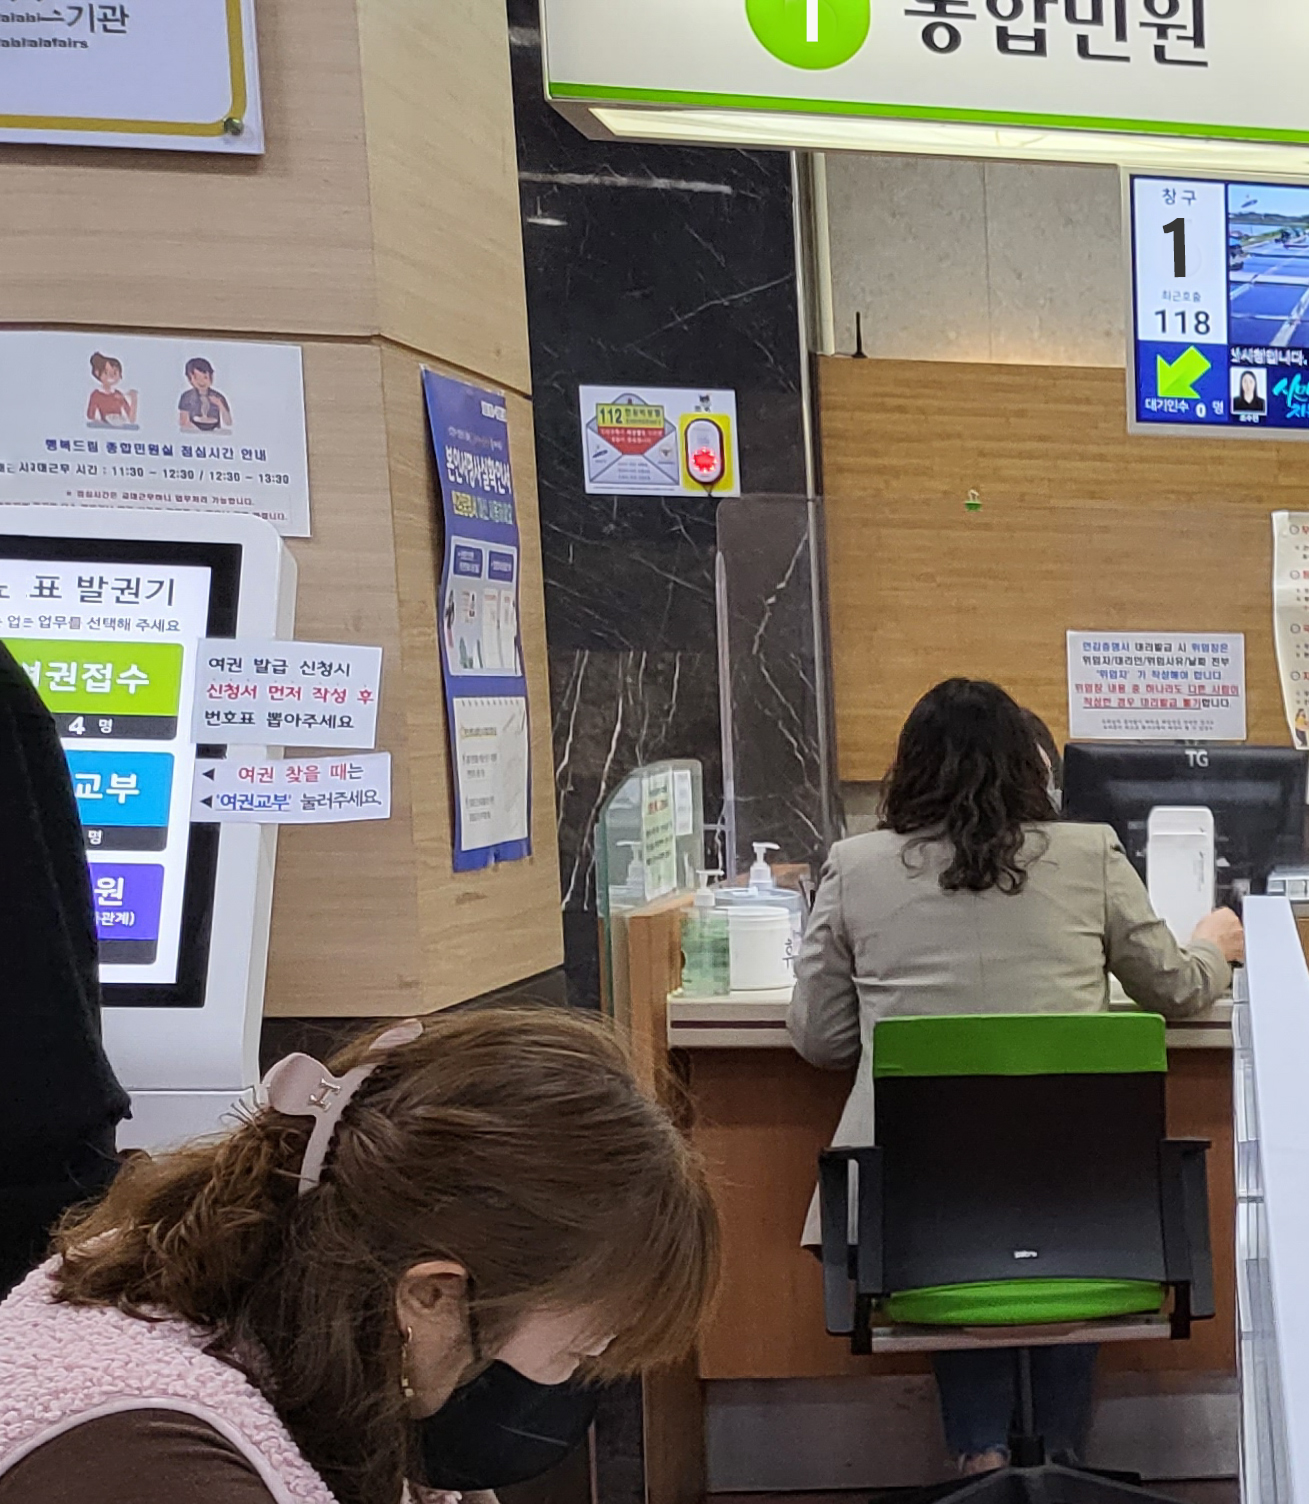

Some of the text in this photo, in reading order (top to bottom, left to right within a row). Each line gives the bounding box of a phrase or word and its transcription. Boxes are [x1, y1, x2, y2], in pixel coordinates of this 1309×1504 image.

[804, 0, 1209, 68] 1 통합민원
[1162, 217, 1187, 278] 1
[1154, 309, 1211, 337] 118
[600, 408, 622, 423] 112
[1145, 397, 1225, 419] 대기인수 0 명
[182, 445, 234, 461] 점심시간
[241, 449, 266, 462] 안내
[76, 465, 289, 484] 시간 11:30 12:30 12:30 13:30
[77, 575, 174, 606] 발권기
[87, 616, 131, 632] 선택해
[136, 618, 181, 632] 주세요
[208, 657, 351, 677] 여권 발급 신청시
[206, 684, 375, 704] 신청서 먼저 작성 후
[68, 717, 113, 734] 4 명
[205, 710, 355, 729] 번호표 뽑아주세요
[1185, 750, 1209, 768] TG
[238, 763, 365, 784] 여권 찾을 때는
[300, 791, 382, 811] 눌러주세요.
[88, 829, 103, 845] 명
